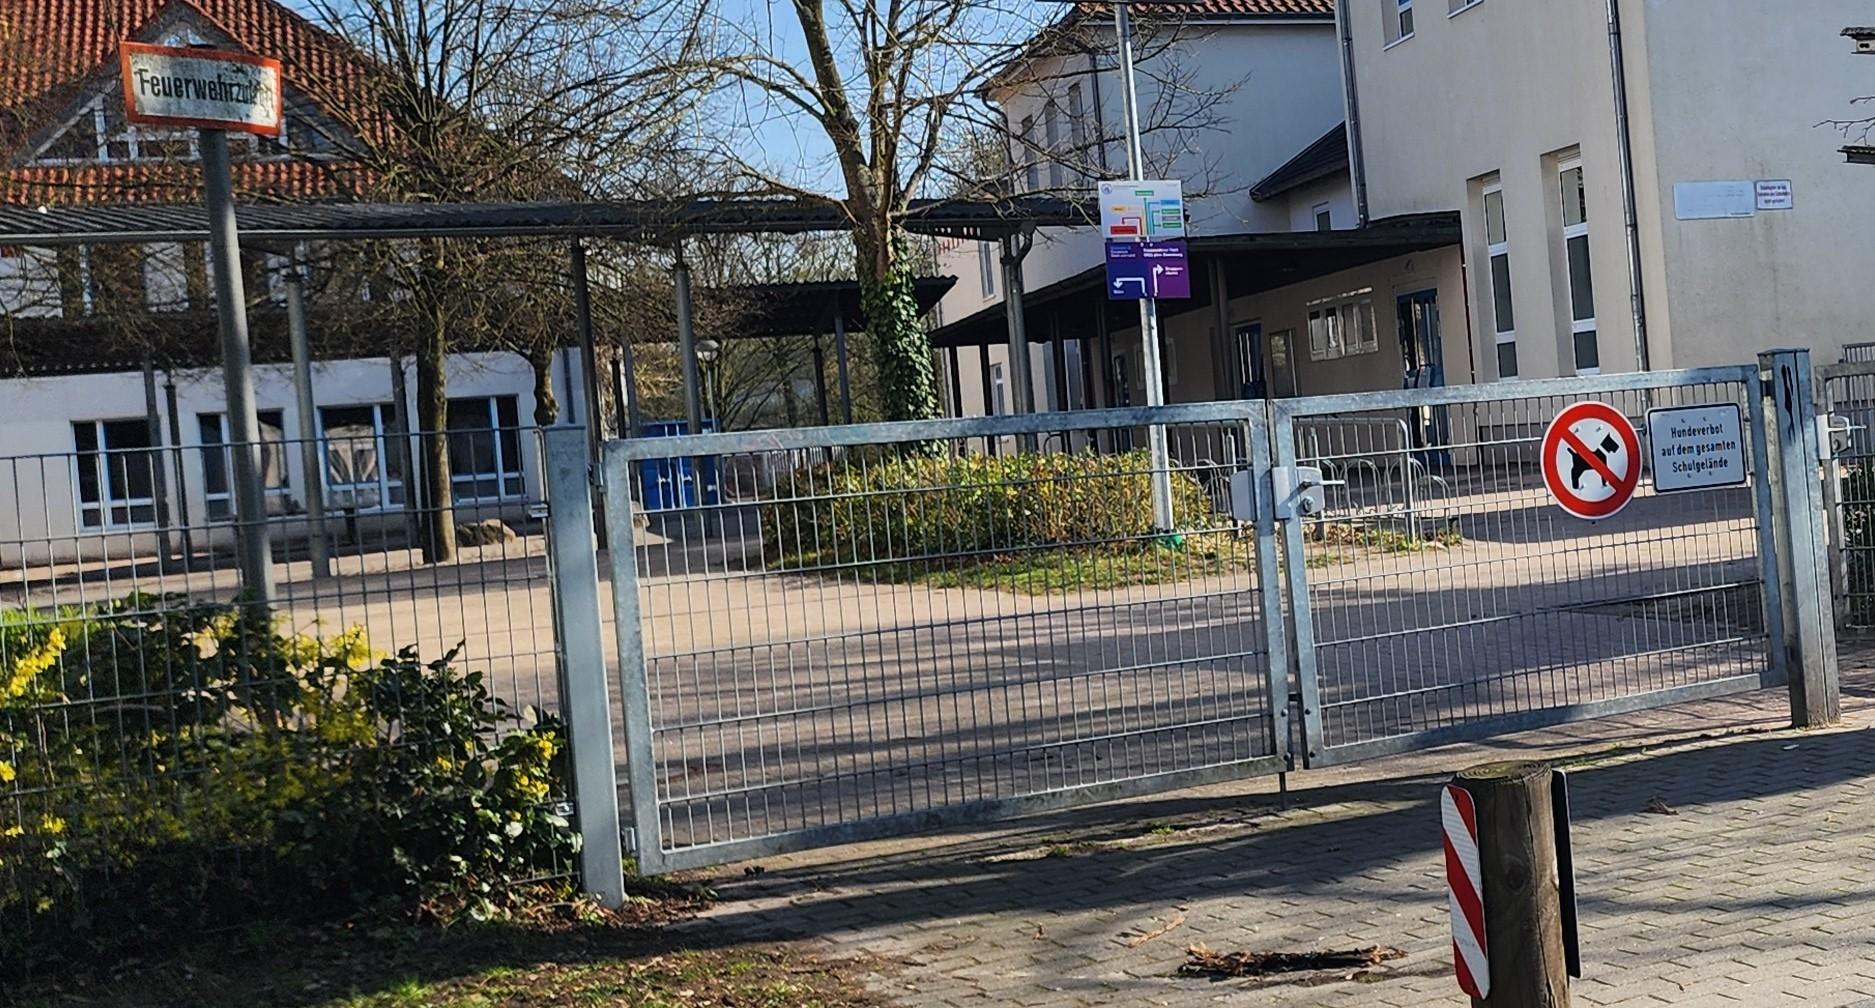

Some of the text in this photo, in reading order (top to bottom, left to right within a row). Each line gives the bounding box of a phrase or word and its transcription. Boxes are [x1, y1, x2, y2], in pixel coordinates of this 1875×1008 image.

[134, 68, 268, 107] Feuerwehrzuf
[1670, 423, 1724, 438] Hundeverbot
[1661, 440, 1736, 457] auf dem gesamten
[1672, 457, 1728, 473] Schulgelände
